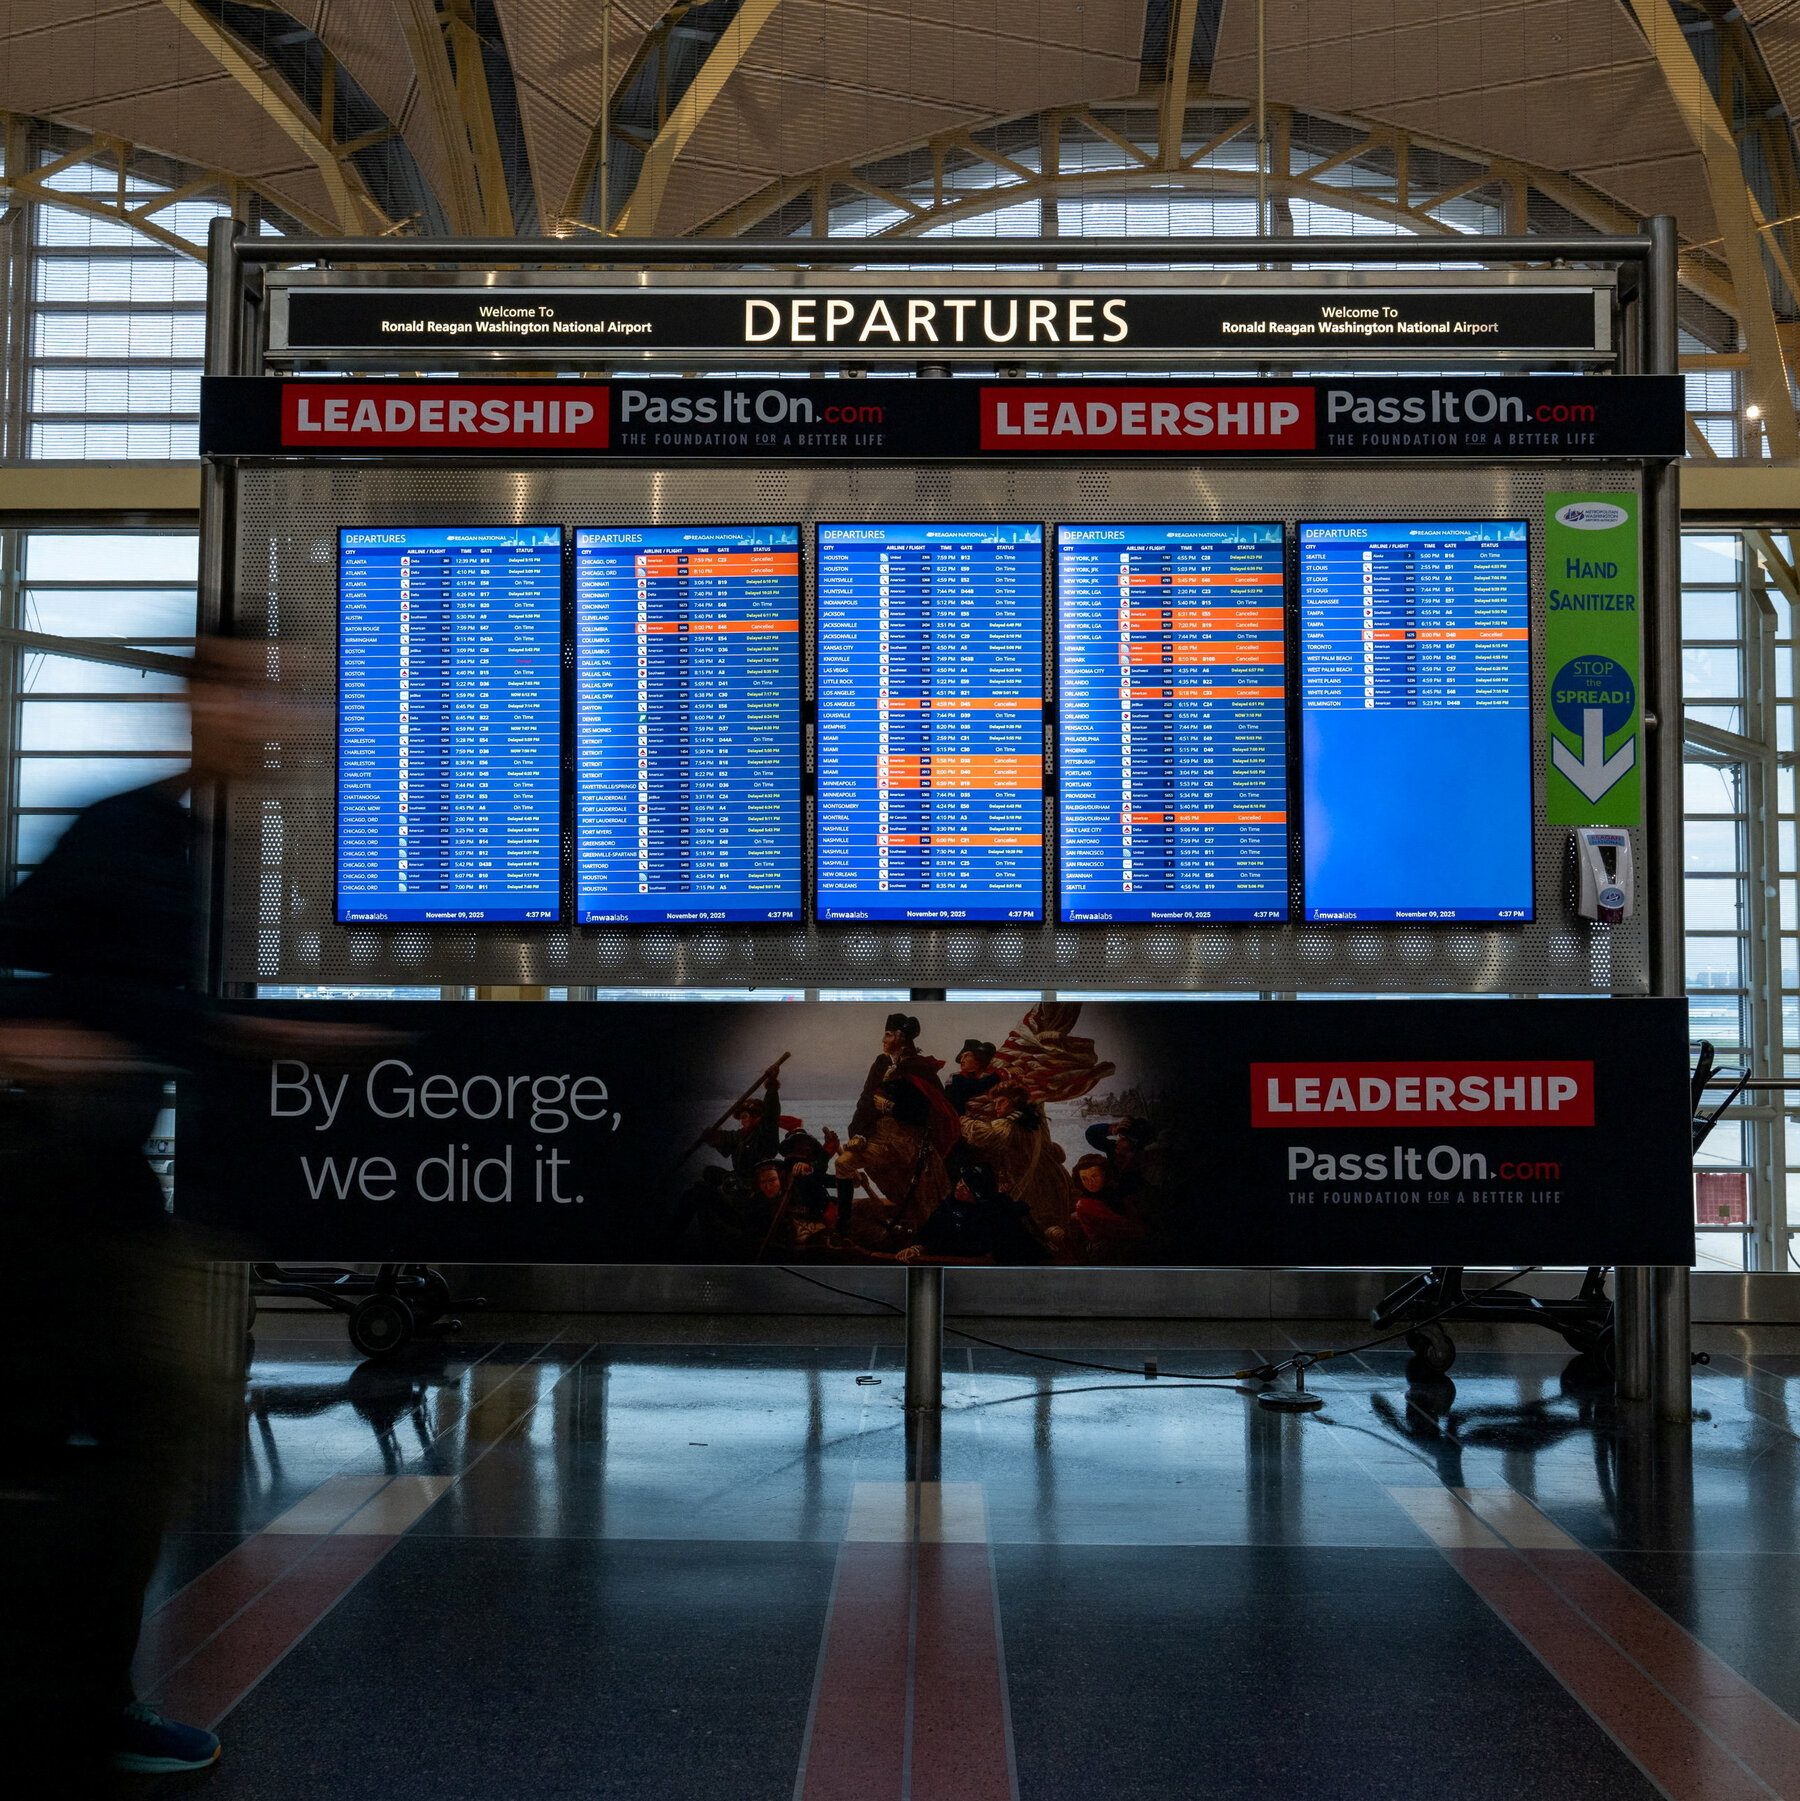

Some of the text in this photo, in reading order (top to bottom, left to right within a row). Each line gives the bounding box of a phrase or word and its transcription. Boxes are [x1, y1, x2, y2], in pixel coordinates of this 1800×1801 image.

[480, 306, 554, 317] Welcome To
[1322, 306, 1398, 318] Welcome To
[382, 321, 652, 335] Ronald Reagan Washington National Airport
[745, 300, 1129, 343] DEPARTURES
[1223, 321, 1498, 335] Ronald Reagan Washington National Airport
[622, 390, 883, 423] PassItOn.com
[1328, 389, 1595, 423] PassItOn.com
[298, 399, 593, 433] LEADERSHIP
[997, 402, 1299, 436] LEADERSHIP
[622, 434, 882, 445] THE FOUNDATION FOR A BETTER LIFE
[1328, 433, 1594, 445] THE FOUNDATION FOR A BETTER LIFE
[346, 534, 406, 543] DEPARTURES
[582, 534, 642, 543] DEPARTURES
[824, 530, 885, 539] DEPARTURES
[1064, 531, 1125, 540] DEPARTURES
[1306, 529, 1367, 537] DEPARTURES
[1566, 558, 1618, 578] HAND
[1549, 589, 1635, 611] SANITIZER
[1572, 661, 1614, 675] STOP
[1585, 677, 1603, 688] the
[1556, 691, 1630, 703] SPREAD!
[271, 1060, 621, 1133] By George,
[1268, 1076, 1578, 1112] LEADERSHIP
[1288, 1145, 1558, 1181] PassItOn.com
[300, 1143, 584, 1203] we did it.
[1289, 1192, 1560, 1204] THE FOUNDATION FOR A BETTER LIFE
